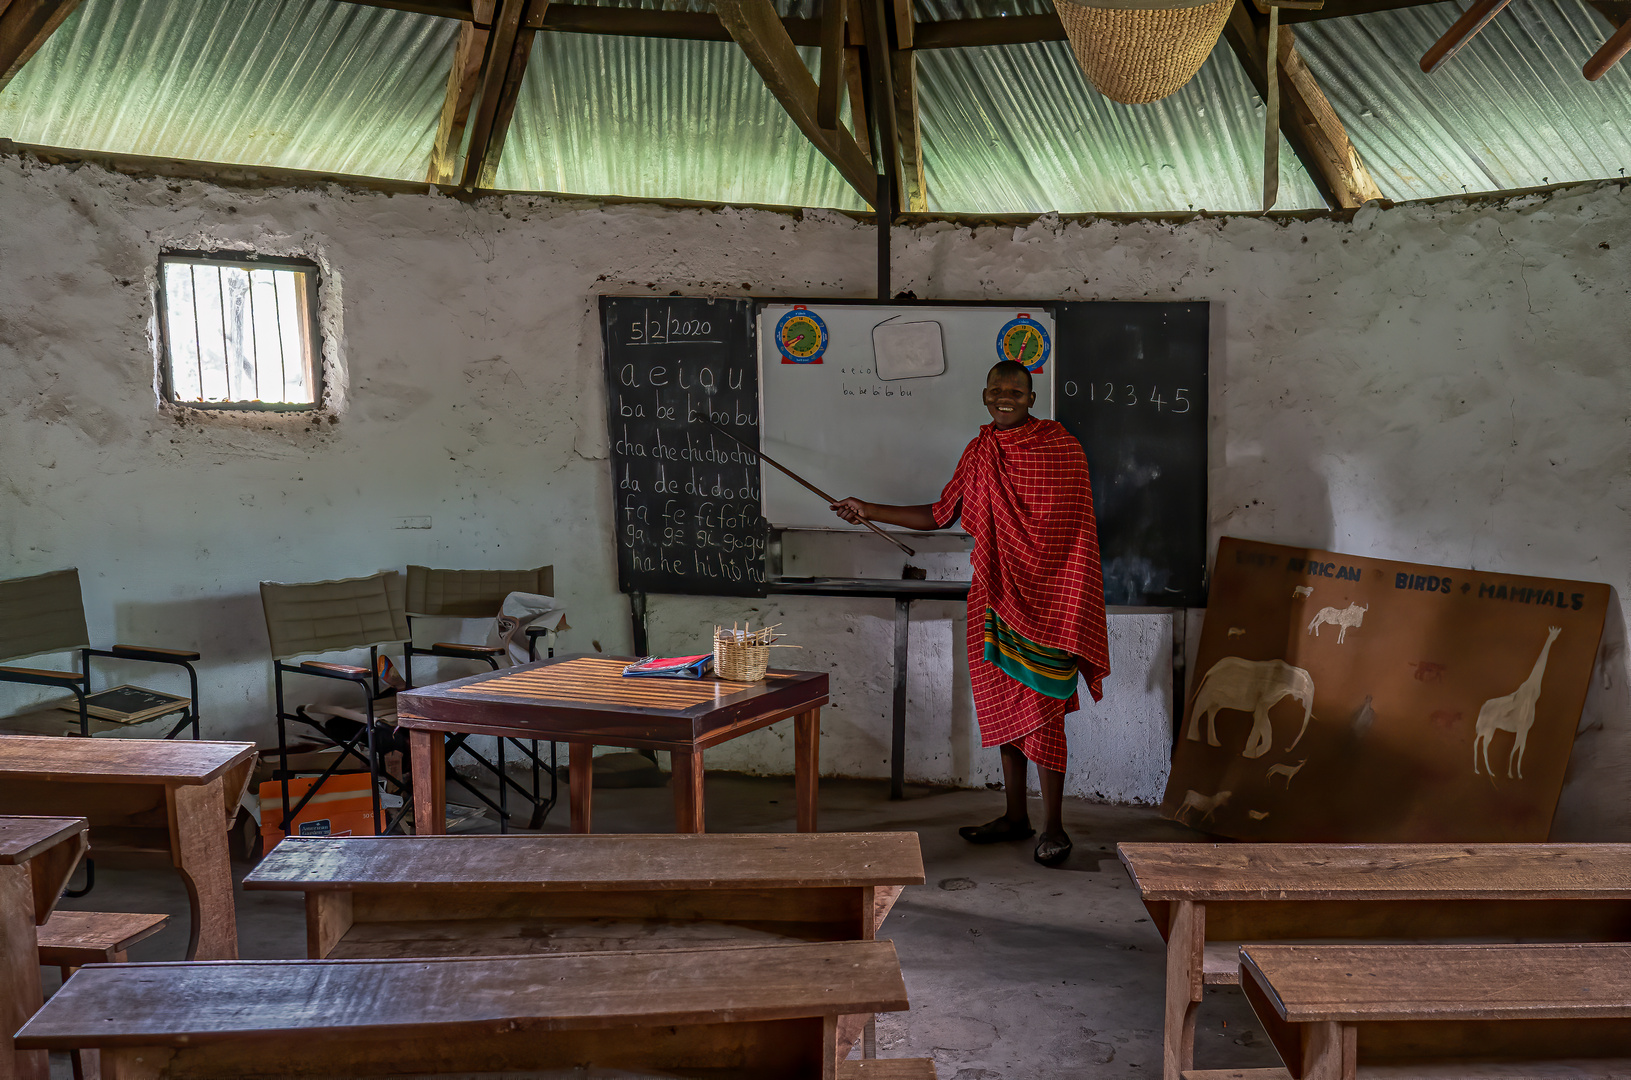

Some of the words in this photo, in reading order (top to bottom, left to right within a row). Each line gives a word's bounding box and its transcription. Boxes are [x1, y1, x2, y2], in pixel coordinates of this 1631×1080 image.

[620, 363, 640, 388] a
[649, 365, 669, 386] e
[678, 359, 691, 390] i
[699, 367, 714, 388] o
[728, 367, 743, 390] u
[842, 382, 855, 396] ba
[900, 385, 912, 397] bu
[619, 394, 646, 418] ba
[655, 389, 676, 421] be
[708, 397, 730, 426] bo
[735, 399, 758, 427] bu
[1064, 380, 1078, 397] 0
[1103, 382, 1115, 402] 2
[1125, 384, 1138, 406] 3
[1150, 385, 1167, 412] 4
[1171, 388, 1190, 414] 5
[615, 423, 647, 458] cha
[651, 428, 678, 462] che
[680, 431, 703, 462] chi
[705, 433, 729, 465] cho
[730, 443, 757, 466] chu
[619, 462, 642, 493] da
[654, 464, 679, 494] de
[684, 466, 708, 497] di
[711, 473, 734, 500] do
[624, 493, 650, 526] fa
[661, 499, 686, 527] fe
[694, 501, 715, 528] fi
[716, 503, 737, 529] fo
[625, 523, 645, 548] ga
[662, 526, 687, 547] ge
[696, 530, 716, 549] gi
[723, 533, 743, 553] go
[632, 548, 656, 573] ha
[660, 546, 686, 576] he
[694, 549, 718, 578] hi
[1395, 572, 1452, 594] BIRDS
[1478, 582, 1585, 611] MAMMALS
